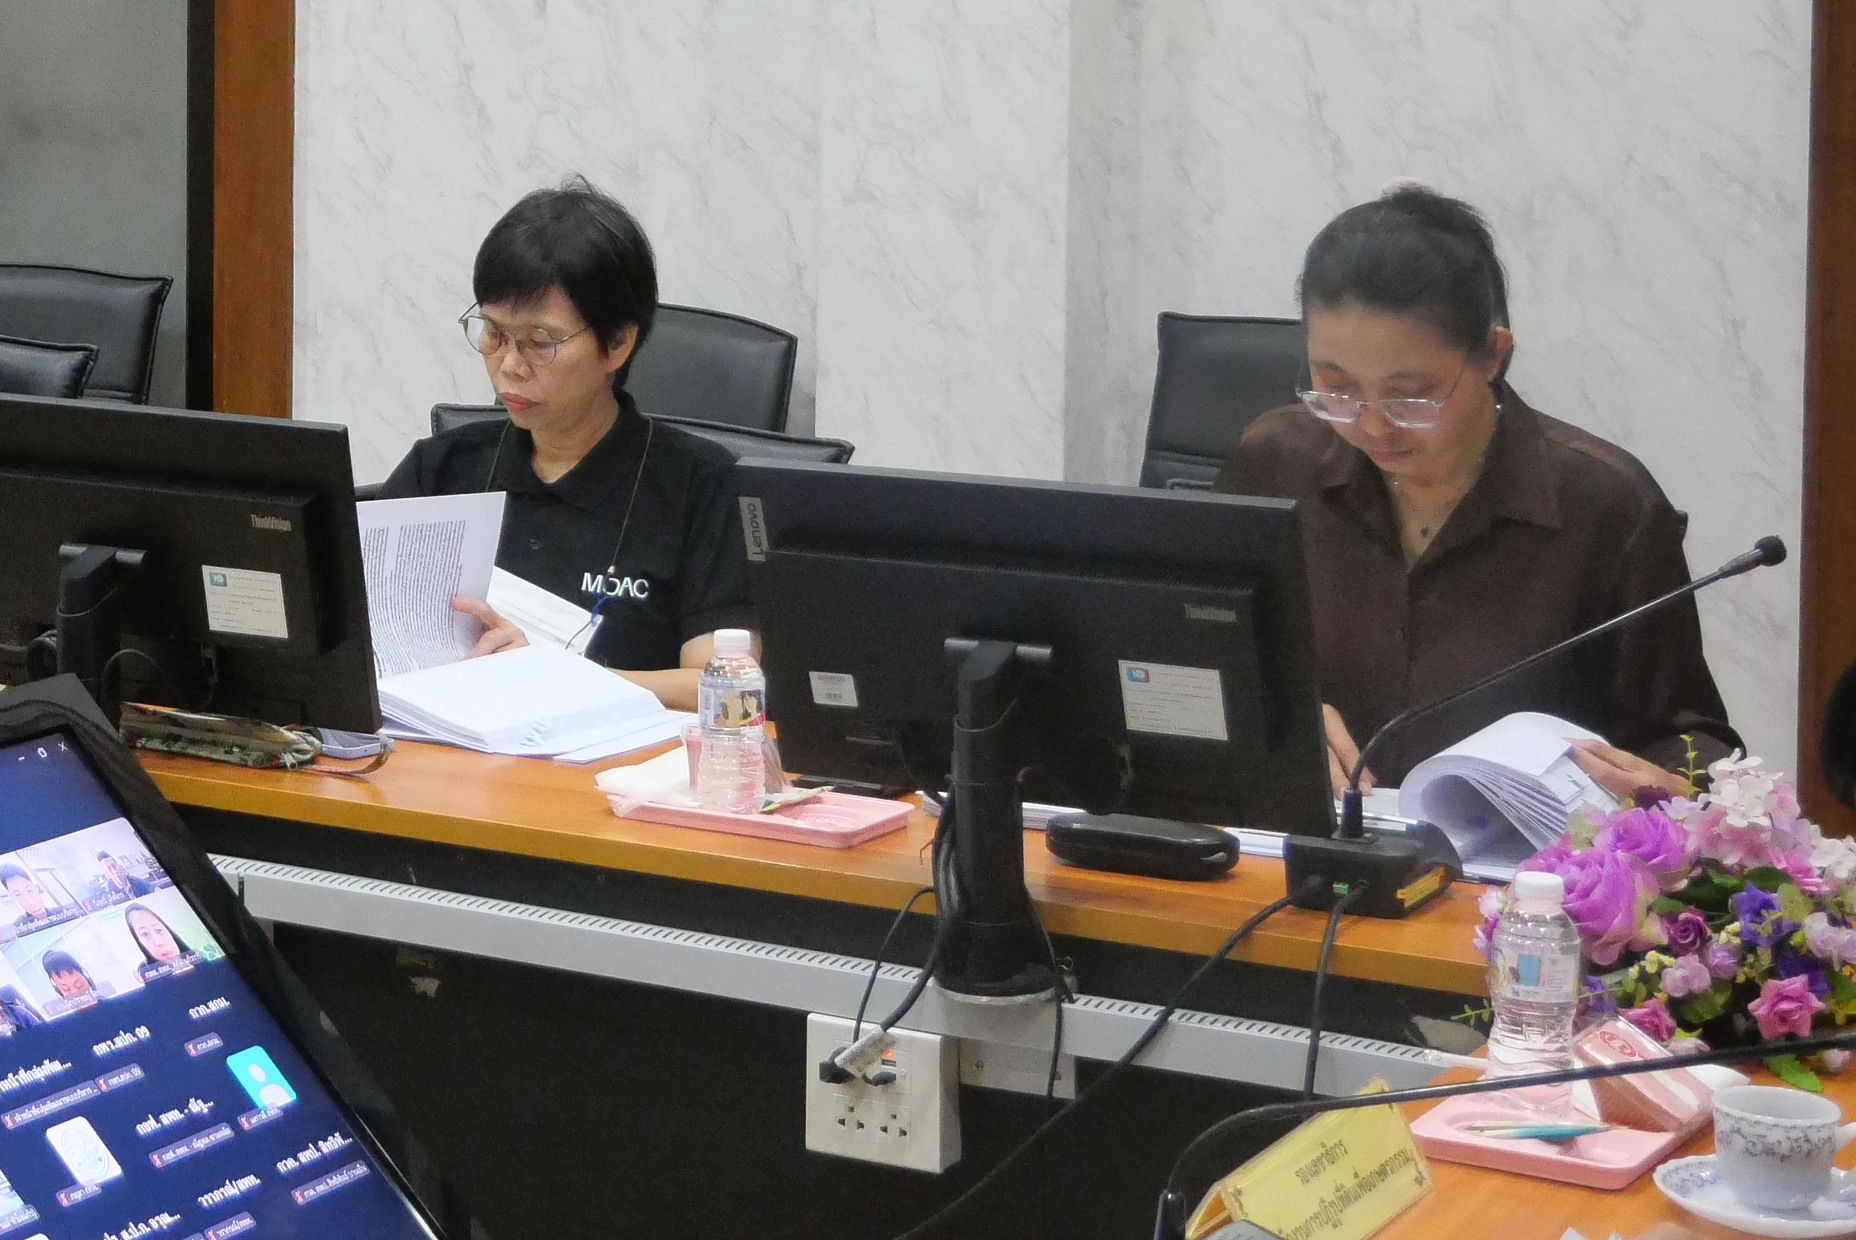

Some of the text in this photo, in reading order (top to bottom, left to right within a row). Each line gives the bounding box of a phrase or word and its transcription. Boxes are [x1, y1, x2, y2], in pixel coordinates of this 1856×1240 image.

[250, 514, 292, 531] ThinkVision
[747, 503, 763, 555] Lenovo
[581, 572, 649, 598] MOAC
[137, 1025, 151, 1041] 09
